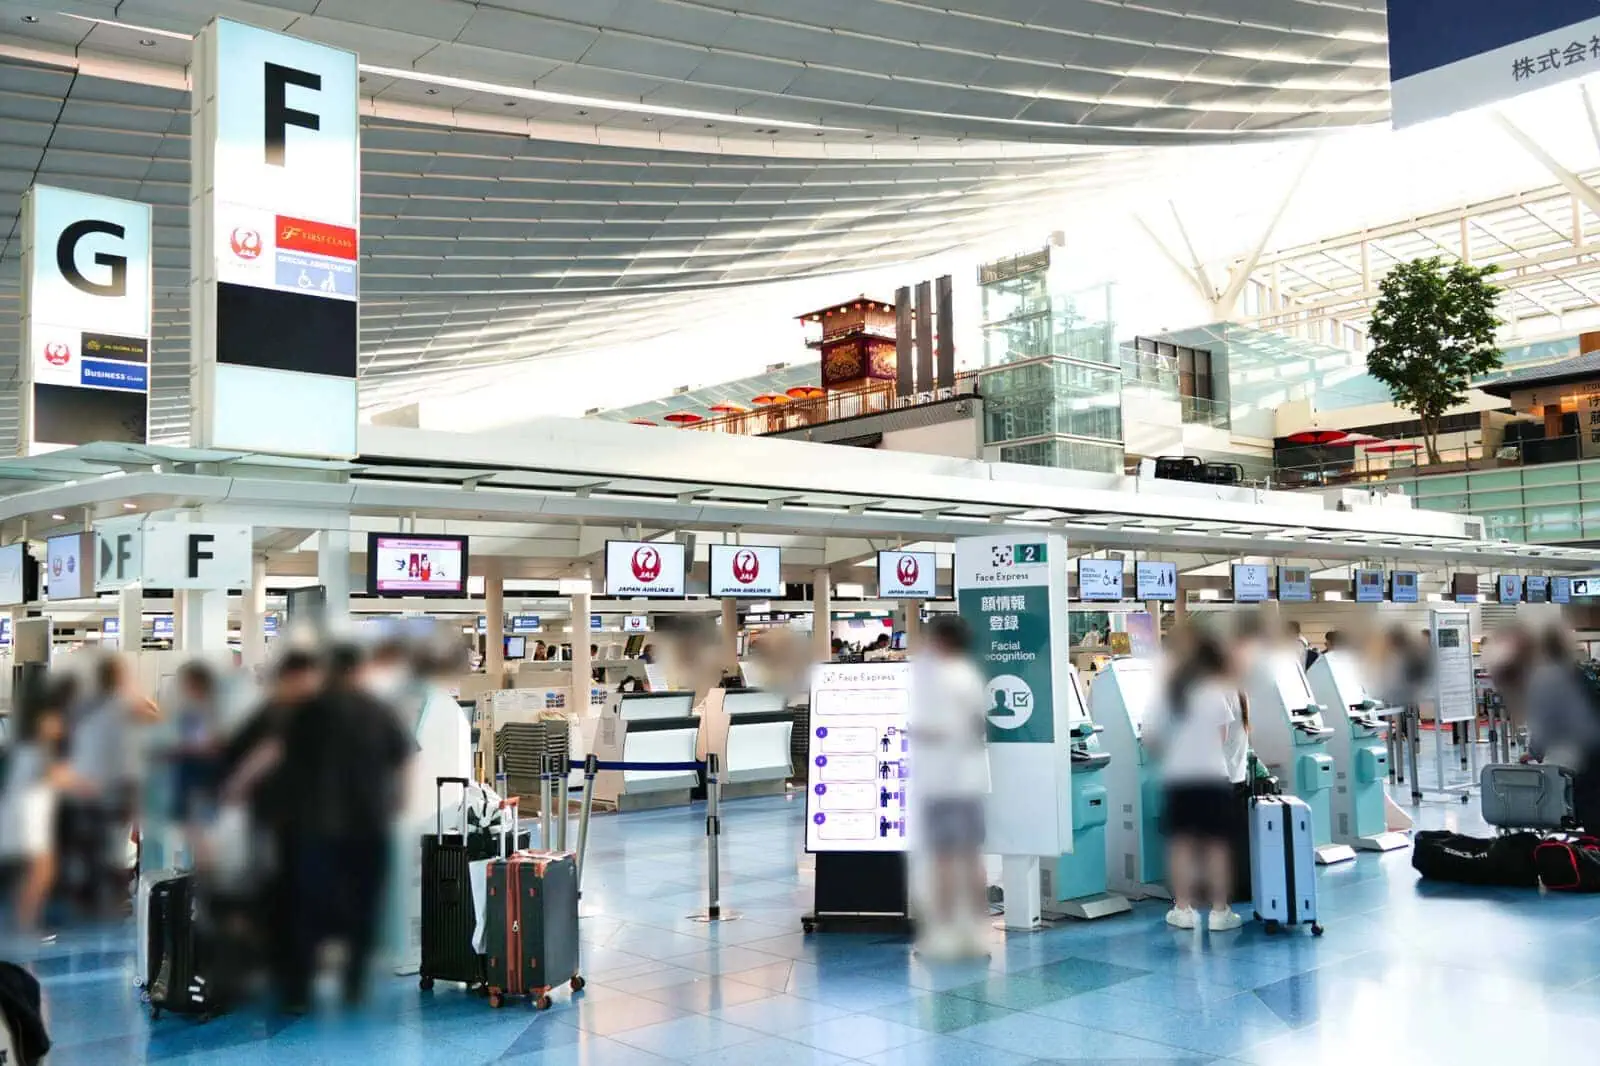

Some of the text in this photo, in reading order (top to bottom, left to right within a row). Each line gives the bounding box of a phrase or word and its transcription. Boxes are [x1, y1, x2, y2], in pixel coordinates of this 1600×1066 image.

[264, 61, 321, 168] F
[57, 220, 127, 297] G
[117, 534, 131, 579] F
[188, 534, 215, 578] F
[1025, 546, 1035, 562] 2
[639, 571, 656, 579] JAL
[975, 571, 1029, 582] Face Express
[981, 594, 1026, 612] 顔情報
[989, 615, 1020, 631] 登録
[991, 640, 1020, 651] Facial
[839, 672, 896, 682] Face Express
